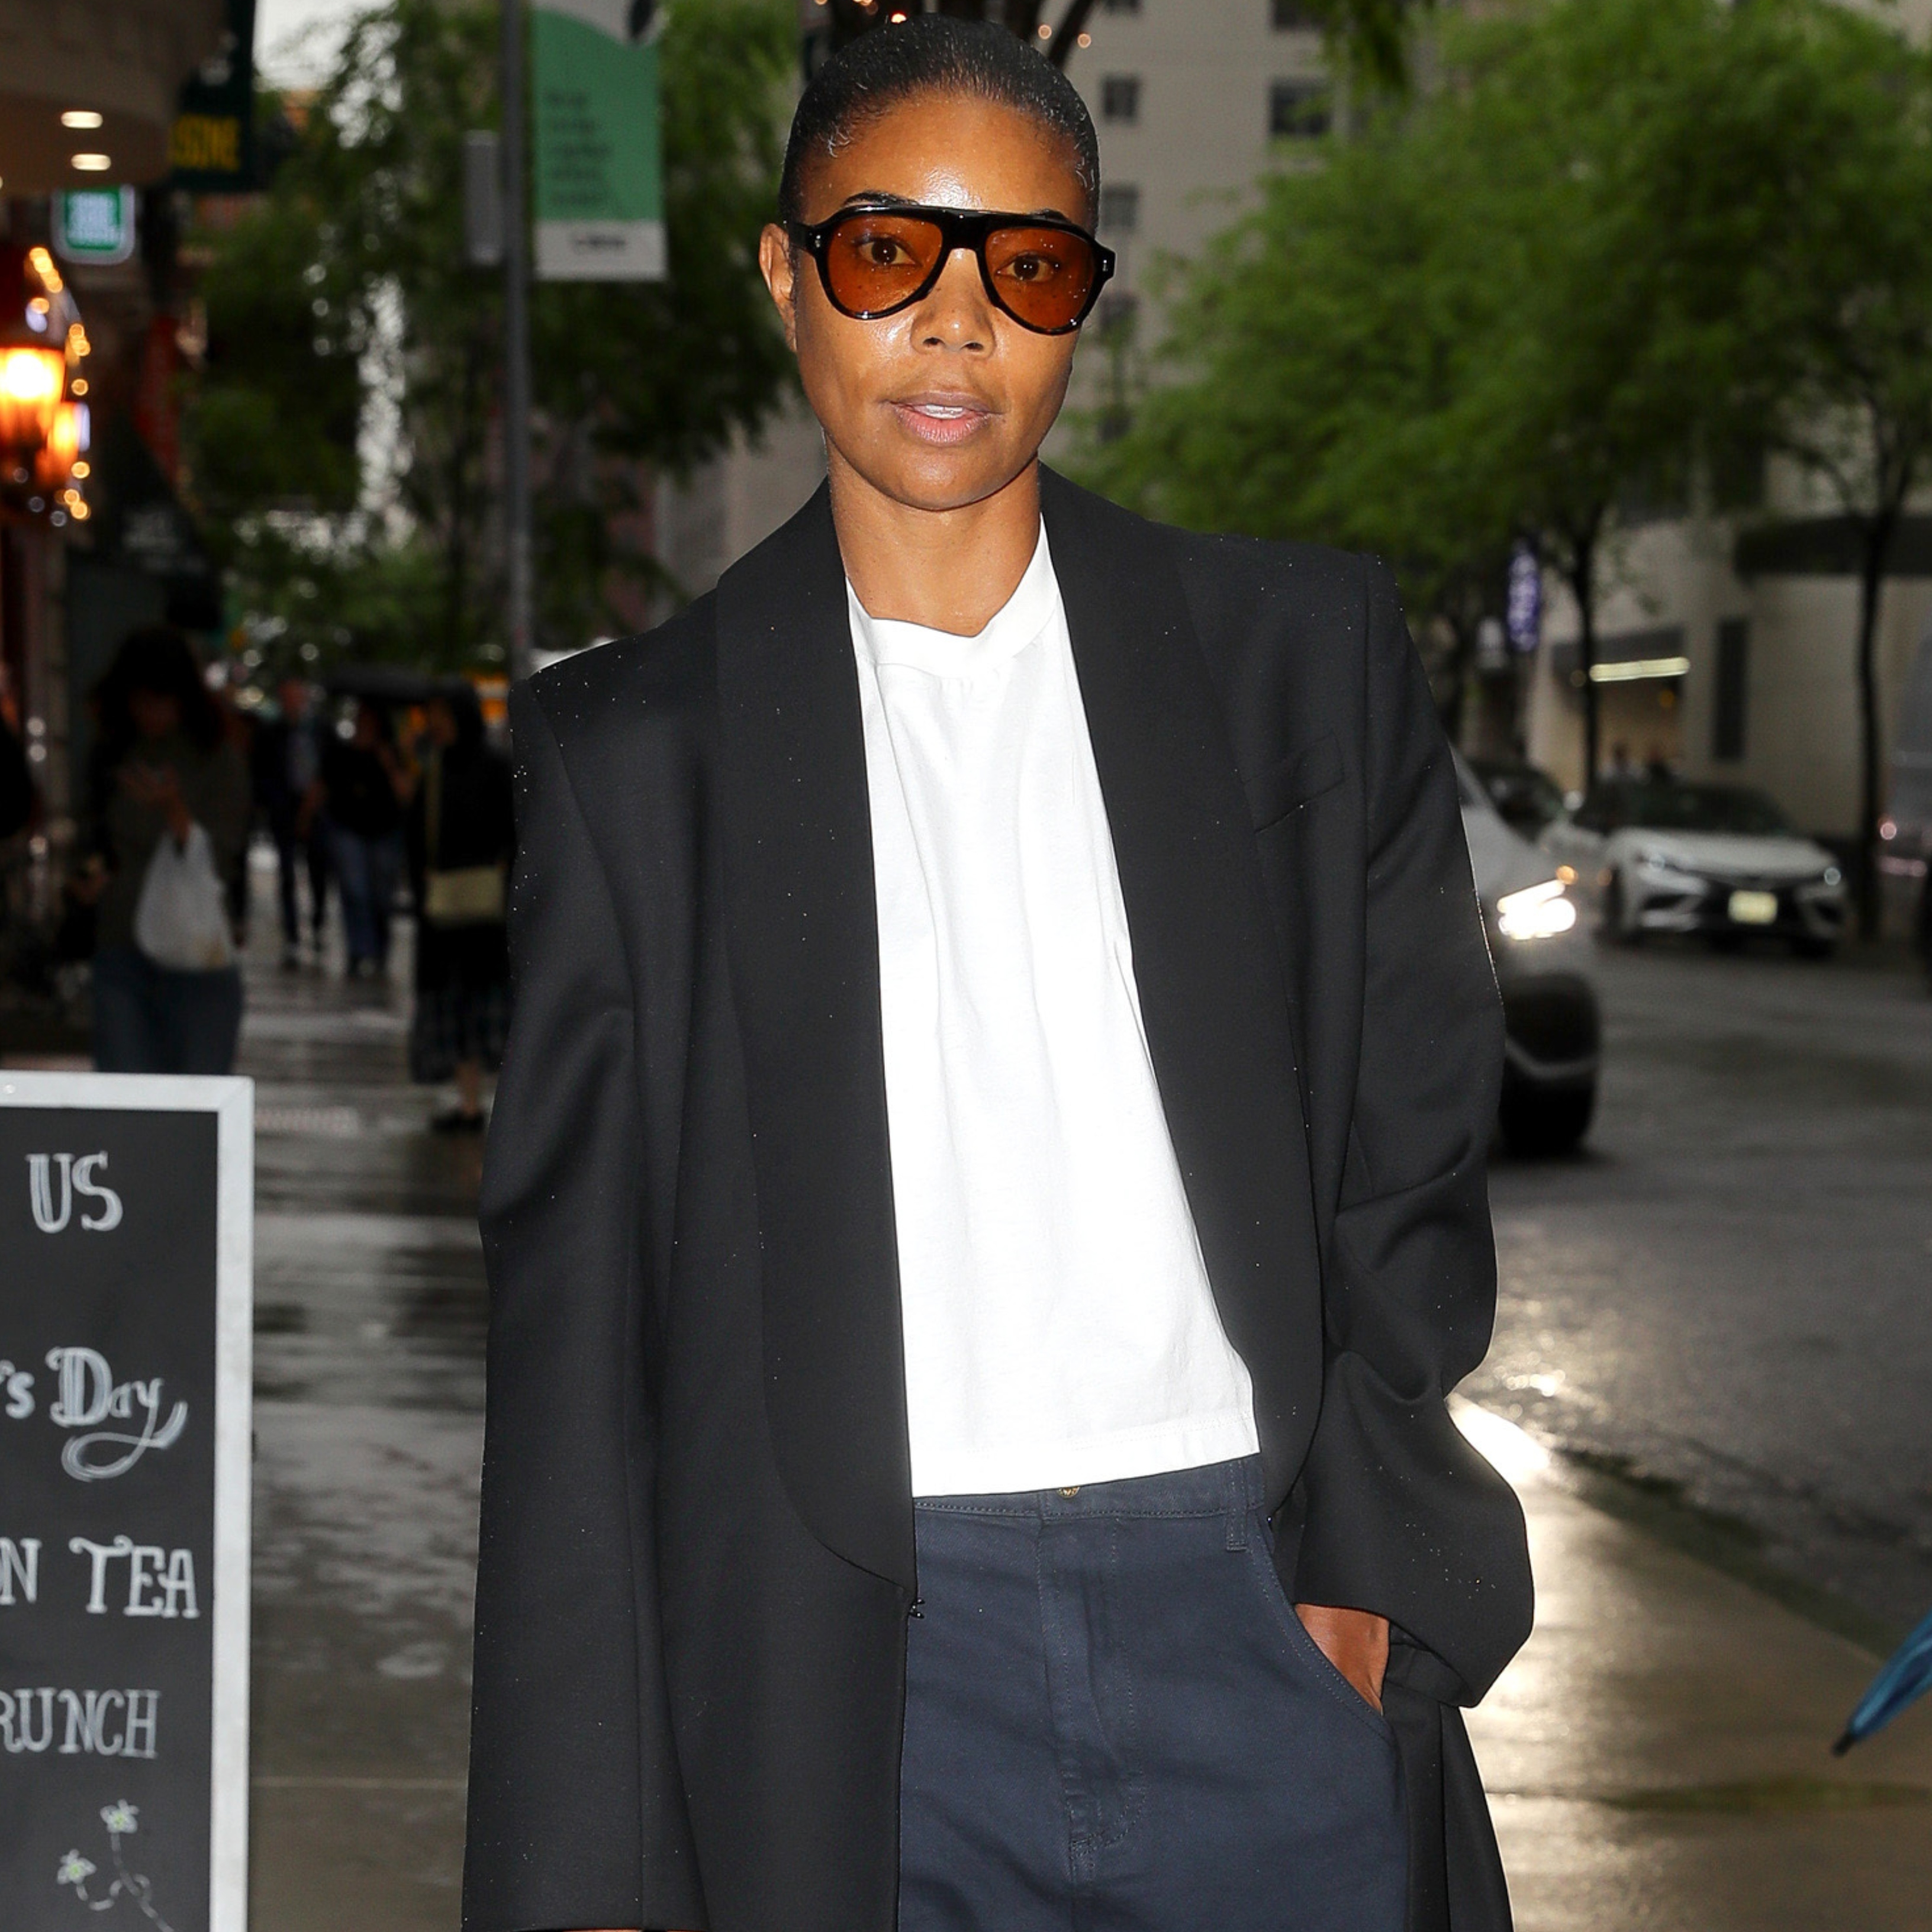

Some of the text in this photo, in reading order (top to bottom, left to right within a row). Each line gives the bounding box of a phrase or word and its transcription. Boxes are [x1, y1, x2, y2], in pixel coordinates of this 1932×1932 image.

[26, 1151, 123, 1234] US
[45, 1346, 188, 1482] Day
[69, 1535, 200, 1618] TEA
[0, 1687, 161, 1758] RUNCH
